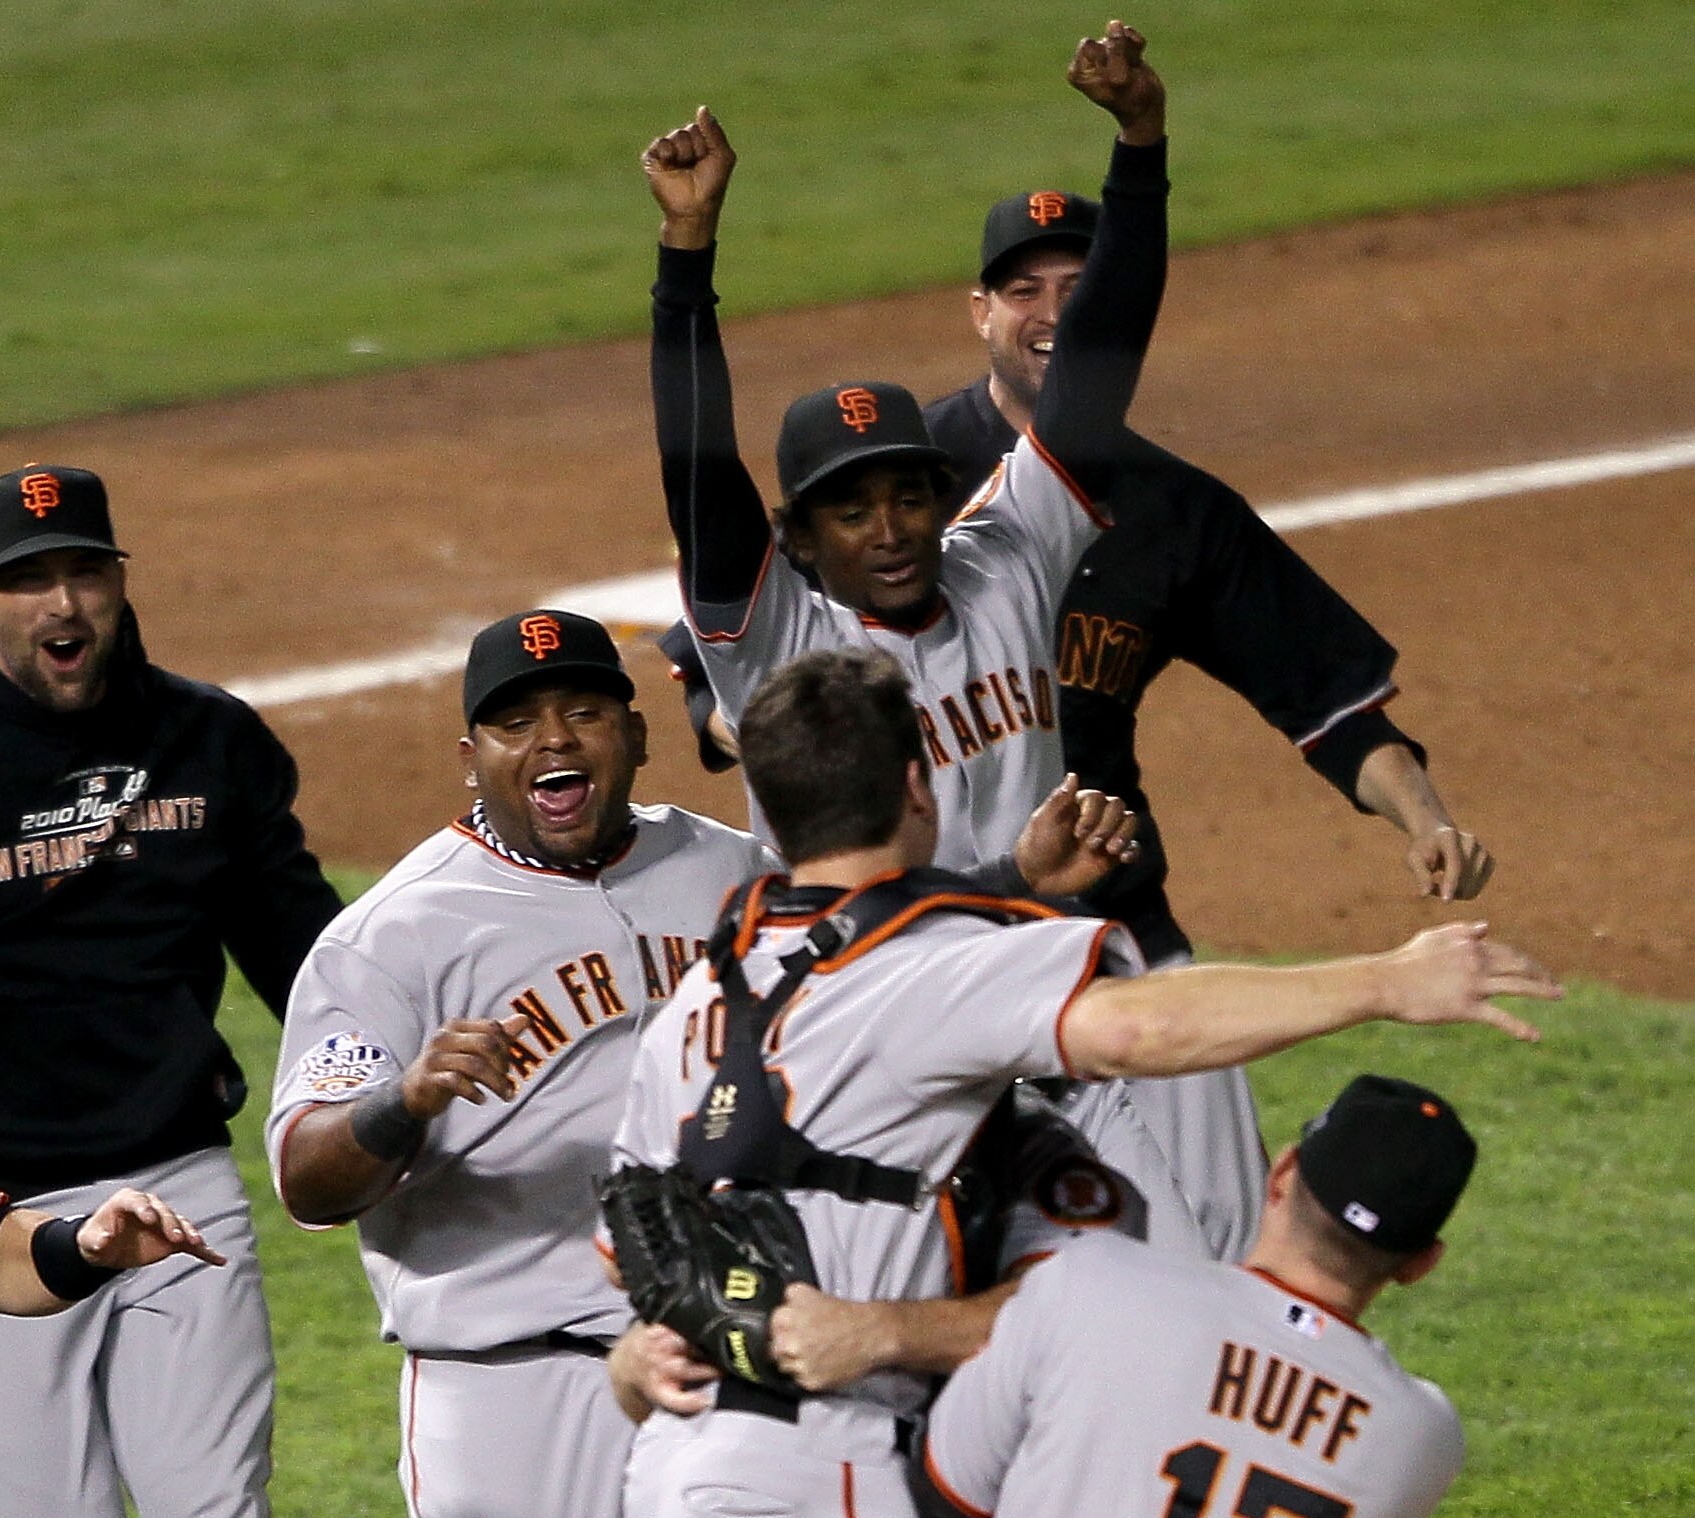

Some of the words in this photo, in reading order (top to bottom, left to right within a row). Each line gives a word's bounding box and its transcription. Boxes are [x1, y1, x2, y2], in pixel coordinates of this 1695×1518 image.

[836, 386, 879, 434] SF
[19, 471, 61, 519] SF
[518, 613, 562, 661] SF
[19, 806, 75, 831] 2010
[505, 986, 574, 1095] AN
[1209, 1340, 1372, 1463] HUFF
